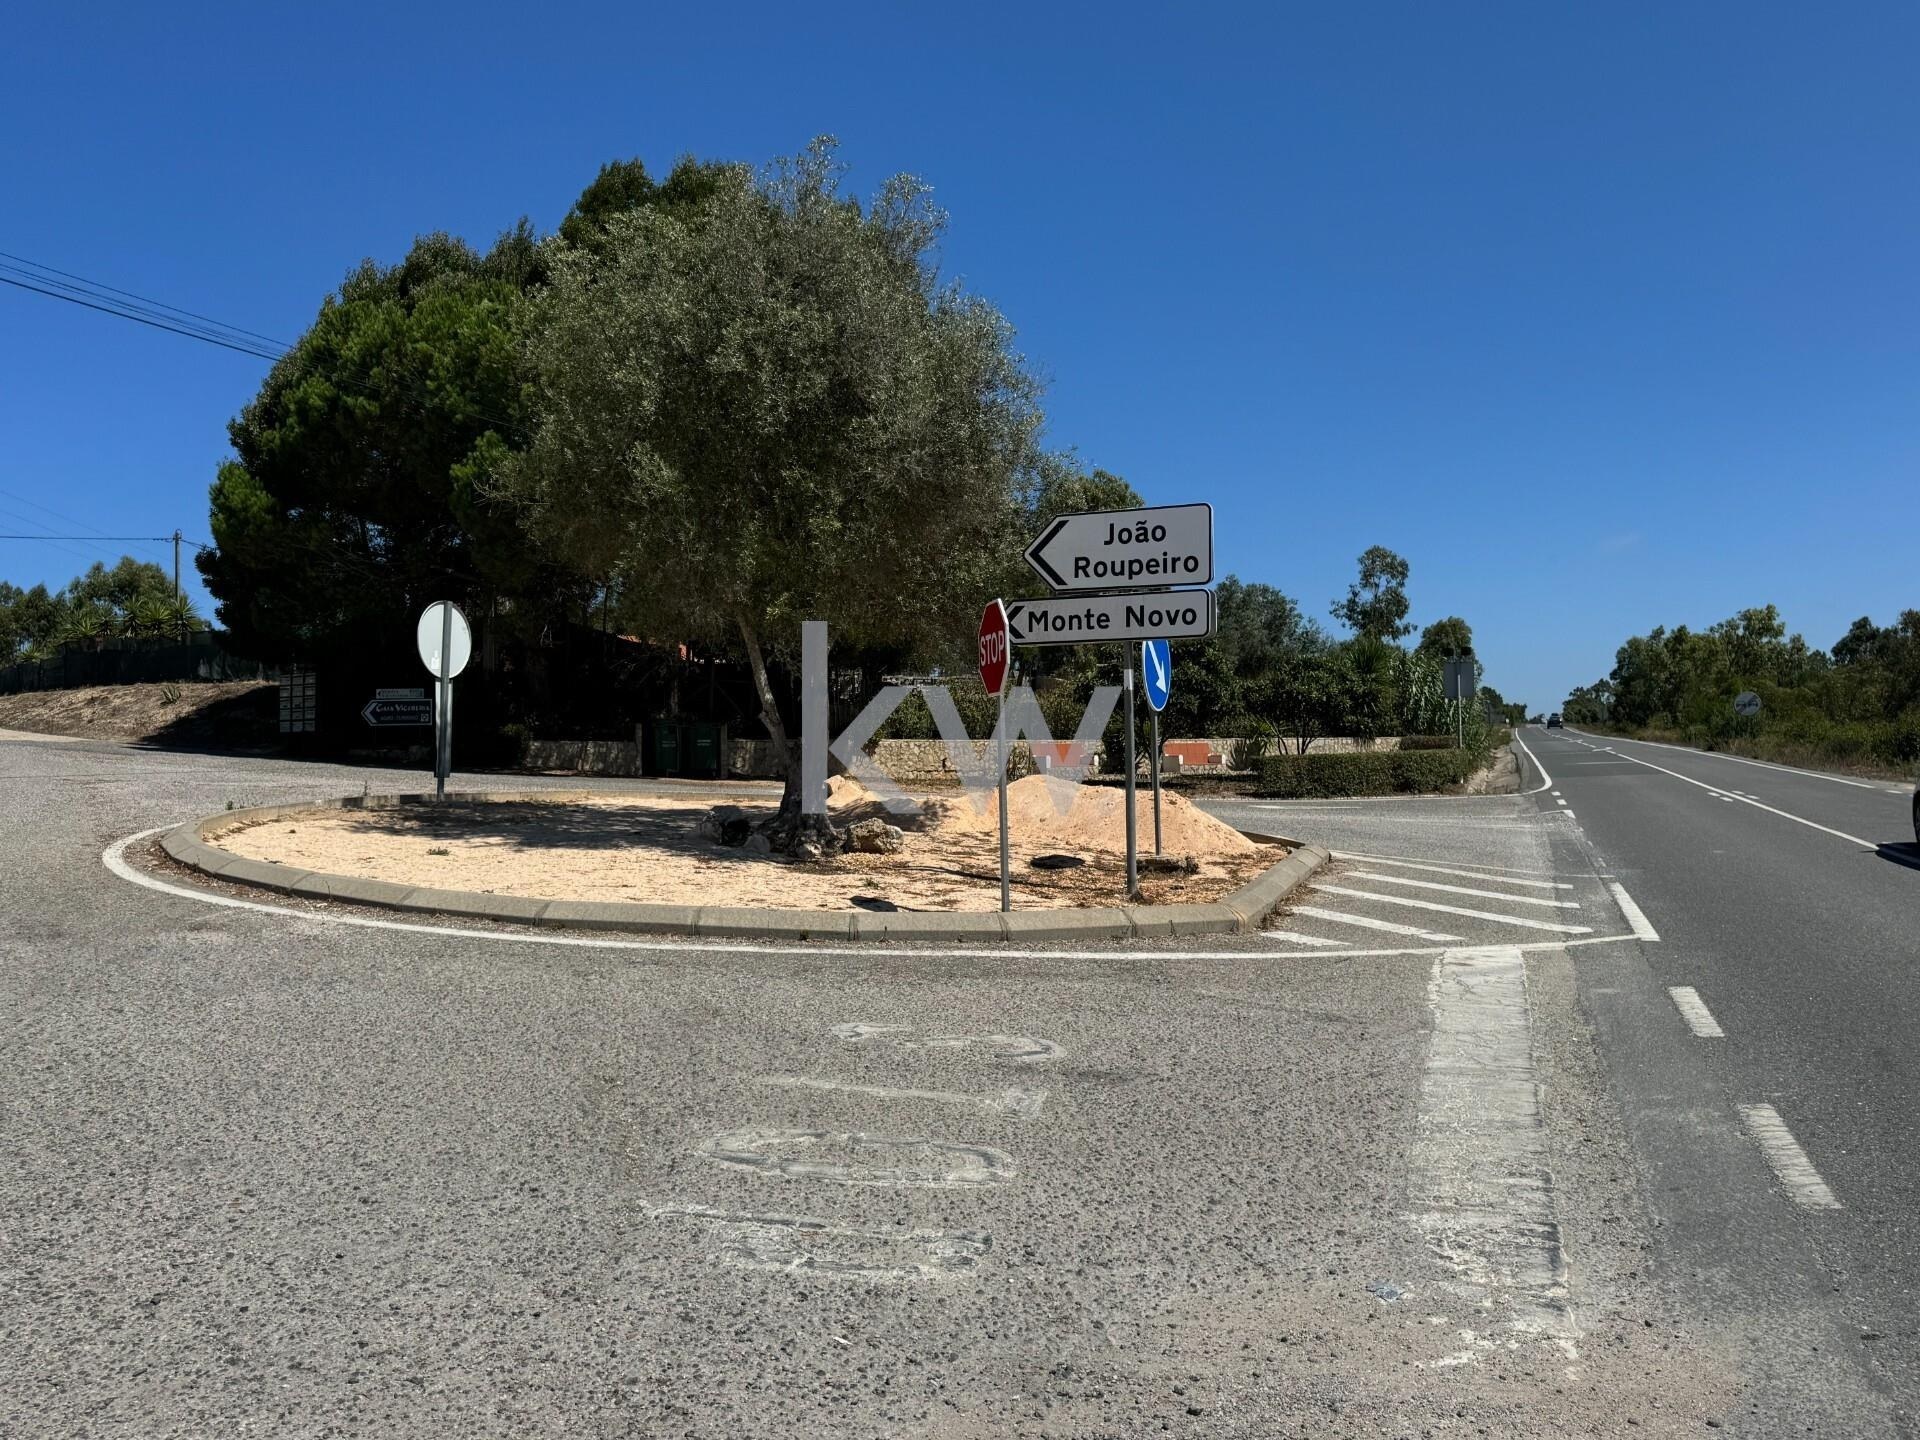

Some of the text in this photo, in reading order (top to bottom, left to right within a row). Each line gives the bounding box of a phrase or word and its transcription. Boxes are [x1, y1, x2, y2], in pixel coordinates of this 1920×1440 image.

[1103, 520, 1167, 546] João
[1074, 552, 1199, 580] Roupeiro
[1028, 605, 1197, 633] Monte Novo
[979, 630, 1006, 667] STOP
